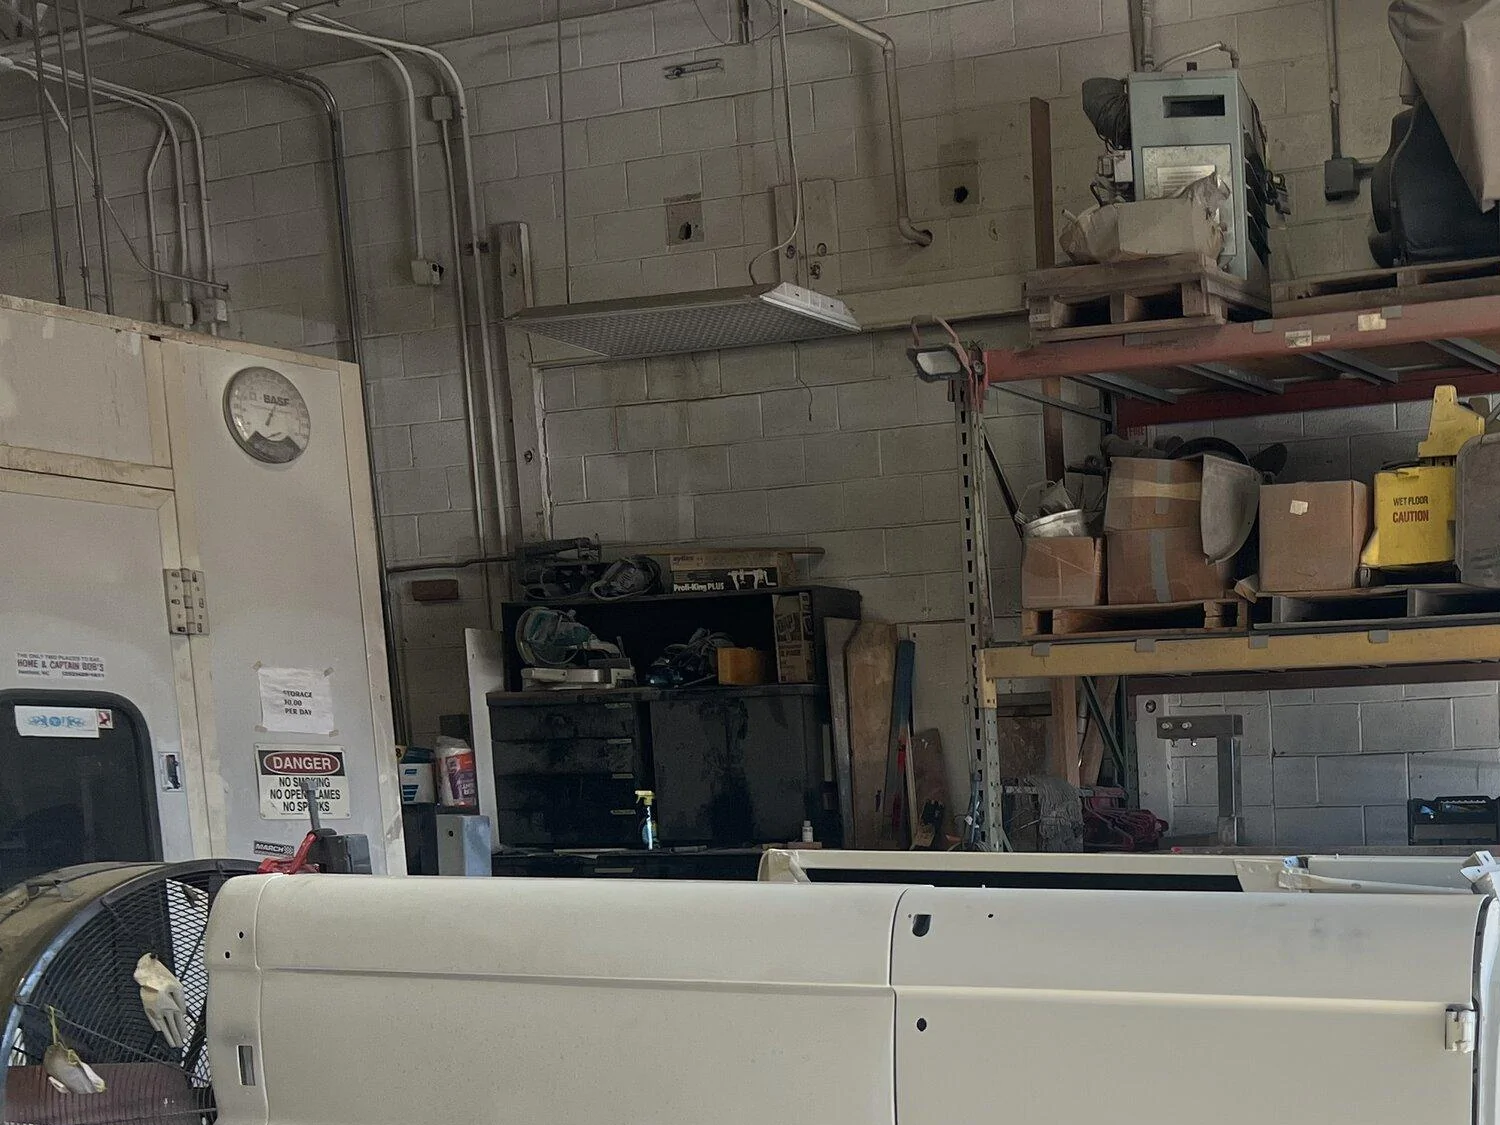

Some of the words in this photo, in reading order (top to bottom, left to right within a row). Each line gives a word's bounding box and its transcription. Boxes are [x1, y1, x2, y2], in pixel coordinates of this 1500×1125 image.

[263, 394, 290, 407] BASF
[1393, 497, 1407, 506] WET
[1407, 495, 1429, 505] FLOOR
[1392, 510, 1429, 523] CAUTION
[707, 582, 725, 591] PLUS
[17, 659, 39, 668] HOME
[49, 660, 80, 670] CAPTAIN
[82, 662, 104, 672] BOB'S
[282, 690, 313, 698] STORAGE
[272, 756, 332, 771] DANGER
[279, 777, 291, 788] NO
[270, 789, 283, 800] NO
[284, 789, 307, 800] OPEN
[283, 801, 296, 812] NO
[297, 801, 330, 812] SPKS
[255, 843, 285, 853] MARCH
